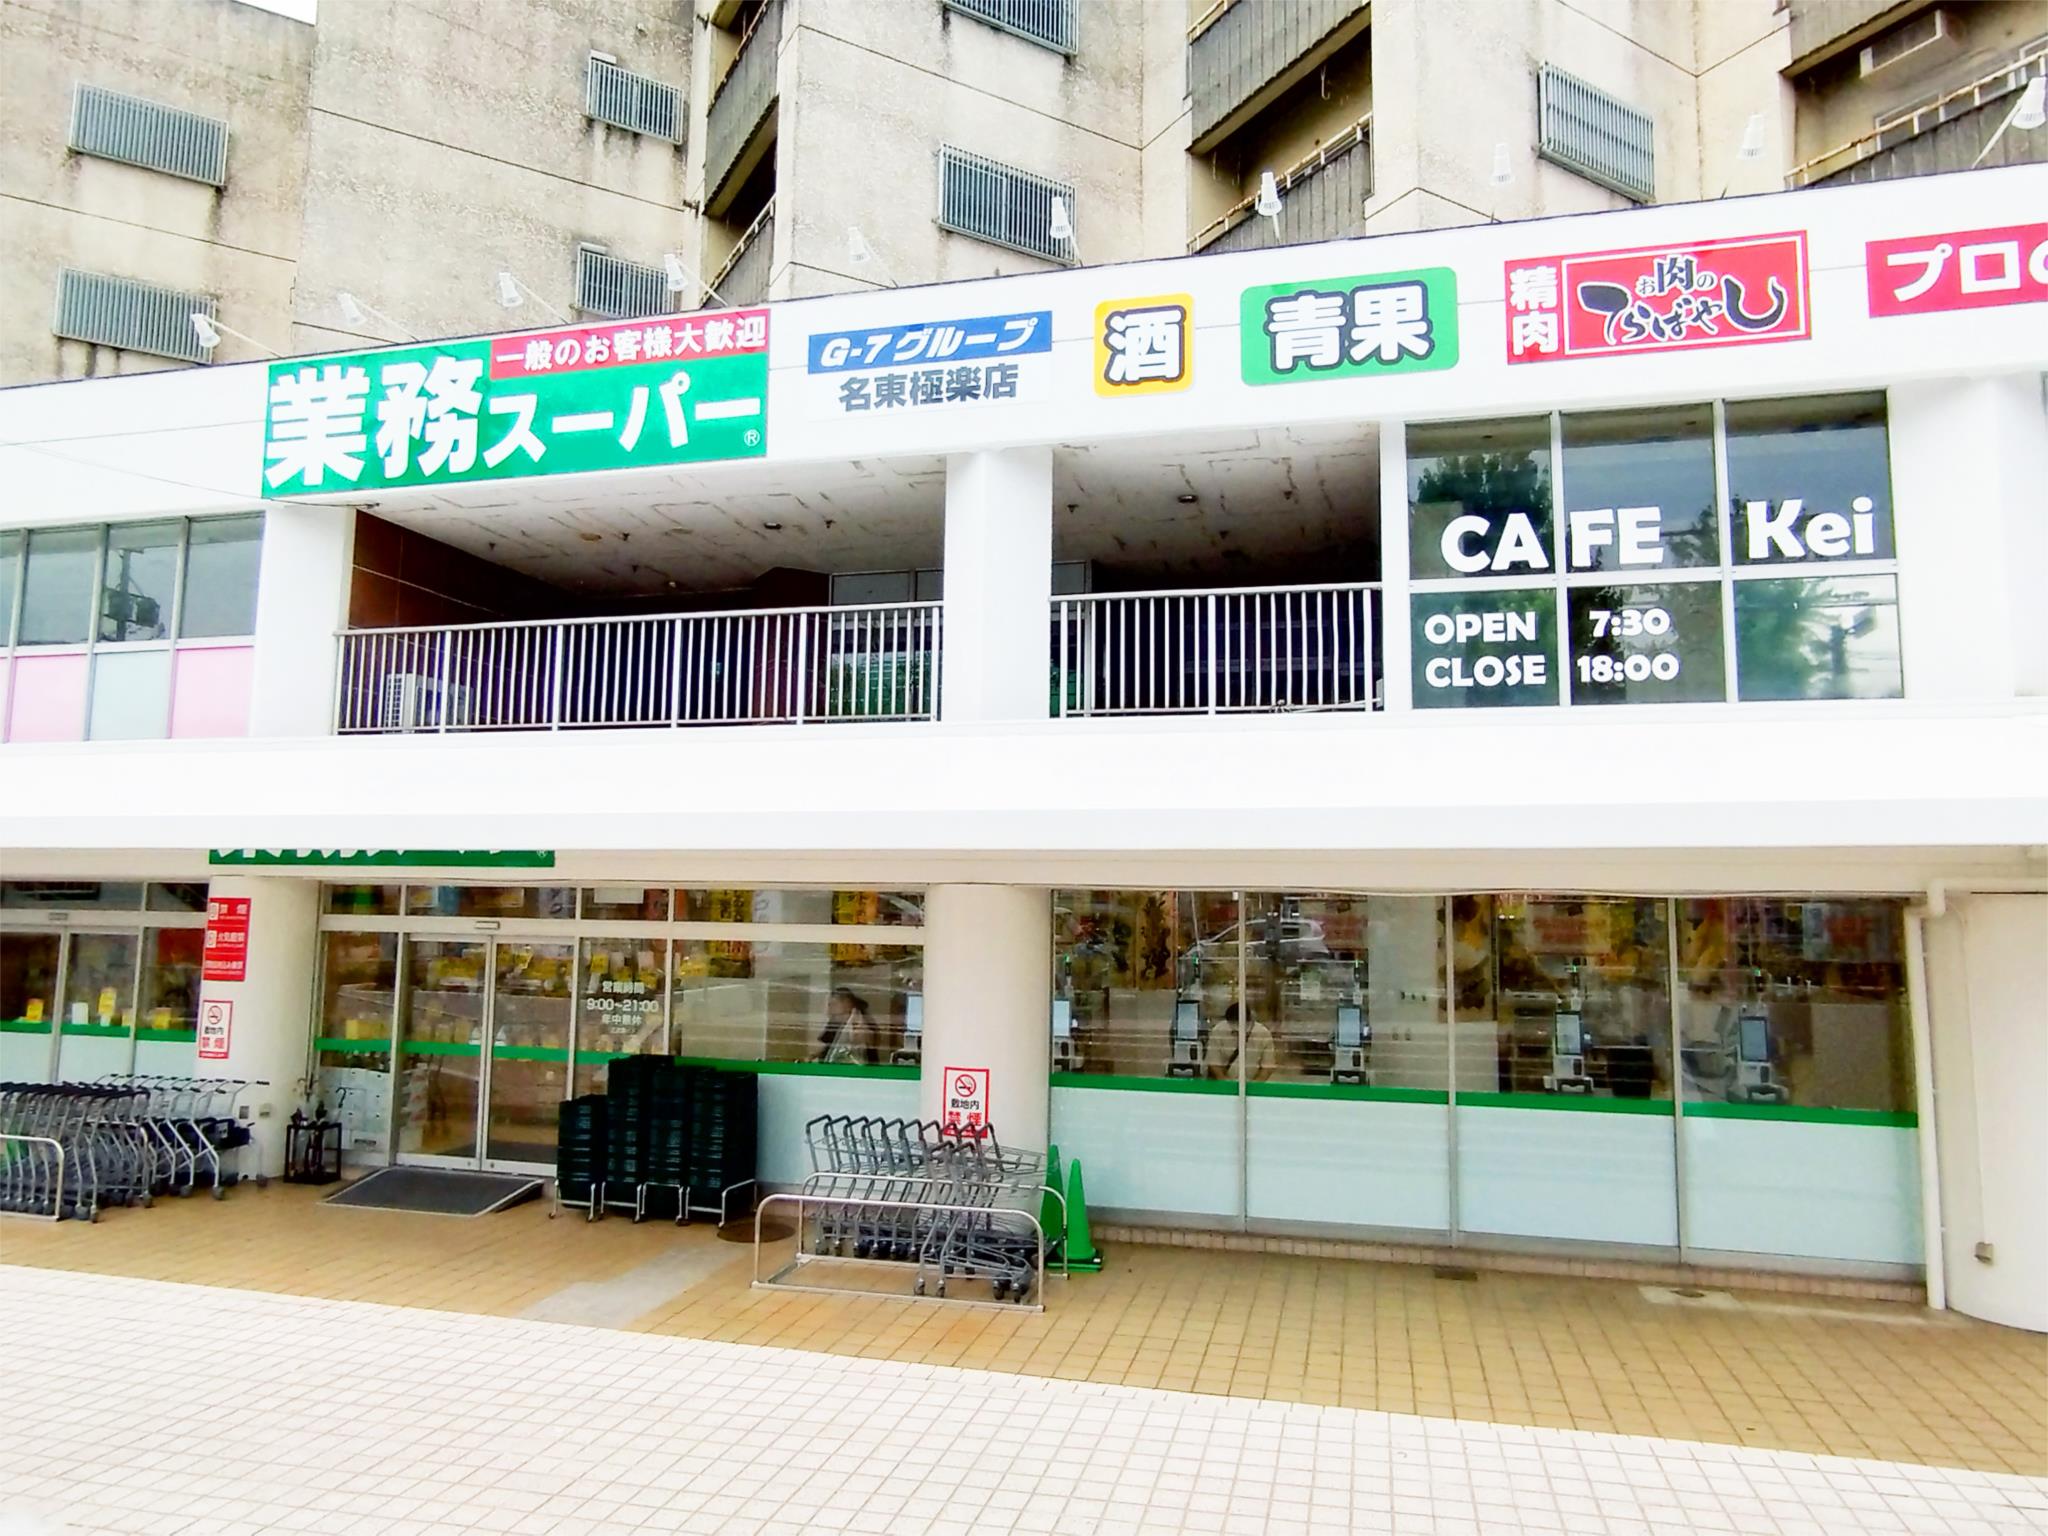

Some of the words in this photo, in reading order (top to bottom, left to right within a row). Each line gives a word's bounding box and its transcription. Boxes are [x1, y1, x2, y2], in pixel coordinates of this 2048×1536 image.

[1637, 254, 1715, 297] お肉の
[1267, 284, 1429, 371] 青果
[1509, 267, 1559, 355] 精肉
[1579, 274, 1788, 345] てらばやし
[496, 315, 766, 373] 一般のお客様大歓迎
[1106, 308, 1185, 383] 酒
[838, 364, 1018, 412] 名東極楽店
[264, 356, 761, 488] 業務スーパー
[1440, 506, 1664, 573] CAFE
[1746, 496, 1875, 559] Kei
[1424, 611, 1537, 645] OPEN
[1588, 608, 1670, 638] 7:30
[1425, 655, 1547, 688] CLOSE
[1577, 653, 1680, 683] 18:00
[951, 1098, 980, 1110] 敷地内
